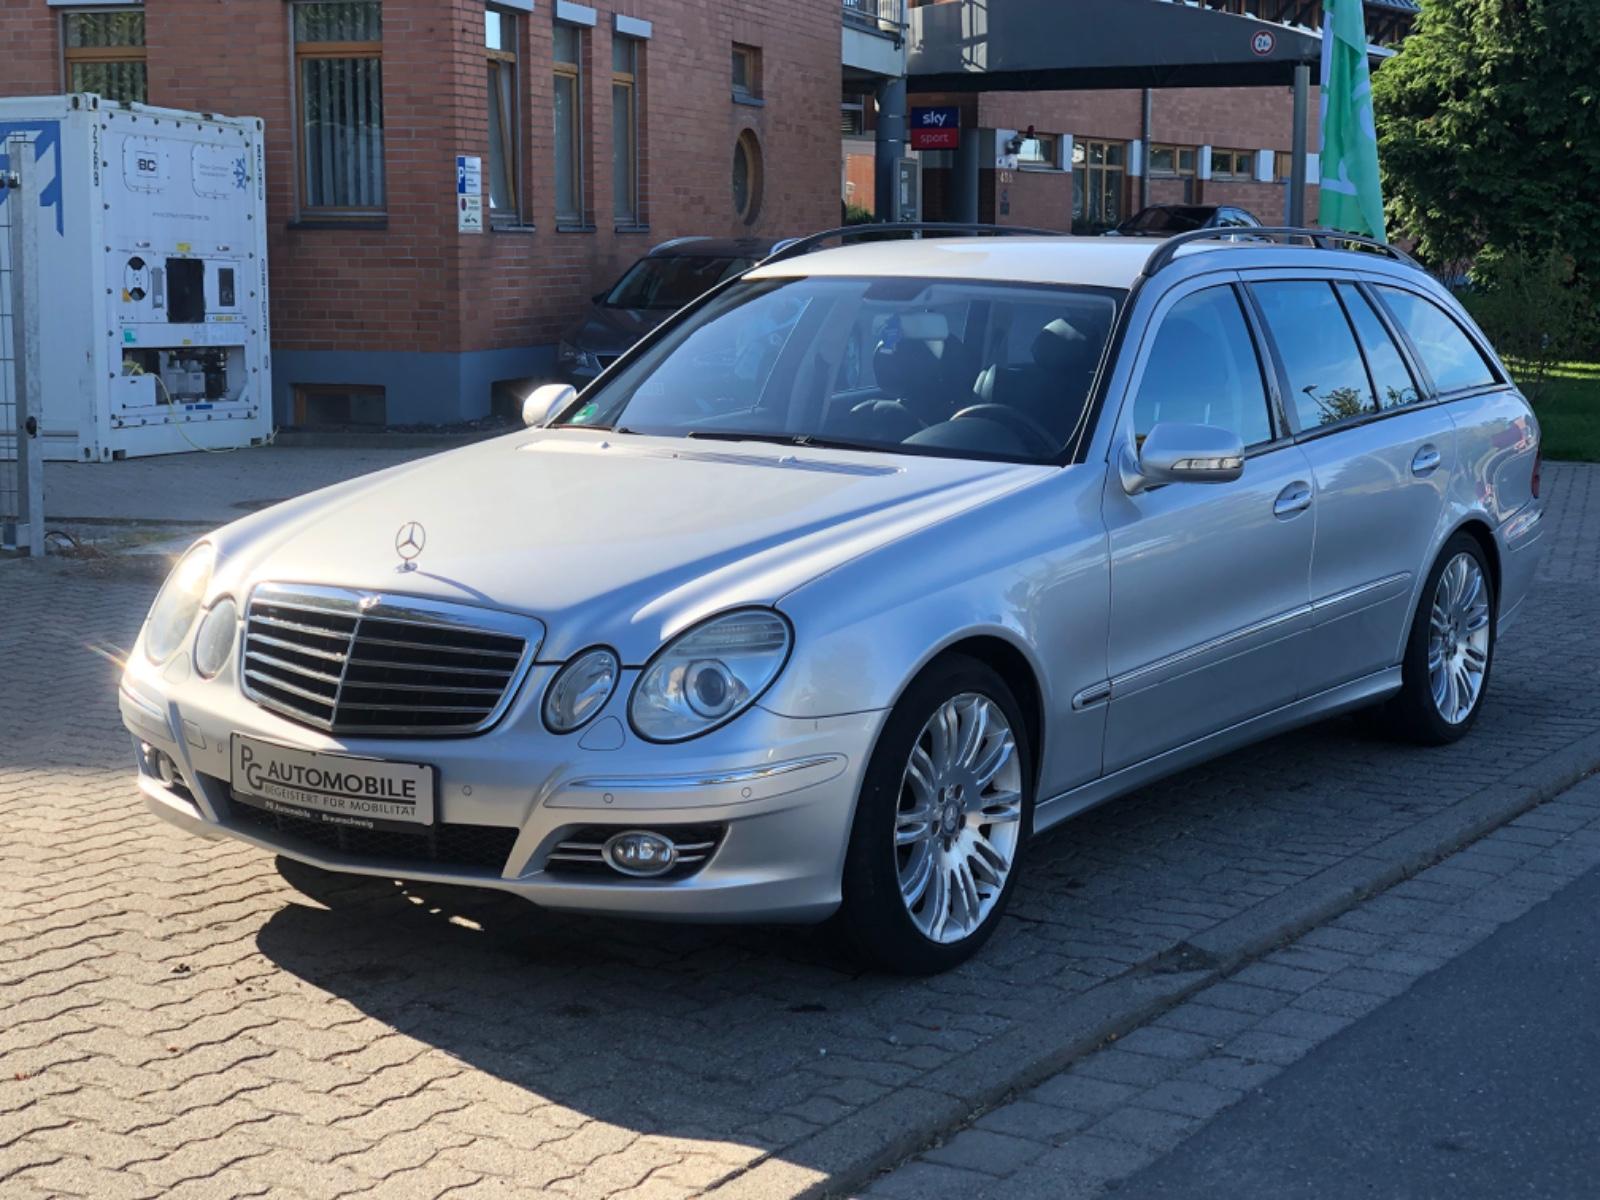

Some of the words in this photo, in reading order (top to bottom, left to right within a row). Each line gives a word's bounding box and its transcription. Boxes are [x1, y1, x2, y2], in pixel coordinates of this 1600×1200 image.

[922, 110, 947, 126] sky
[920, 133, 949, 144] sport
[137, 158, 157, 172] BC
[458, 166, 465, 184] P
[267, 761, 416, 798] AUTOMOBILE
[264, 783, 319, 804] BEGEISTERT
[350, 800, 416, 817] MOBILITÄT
